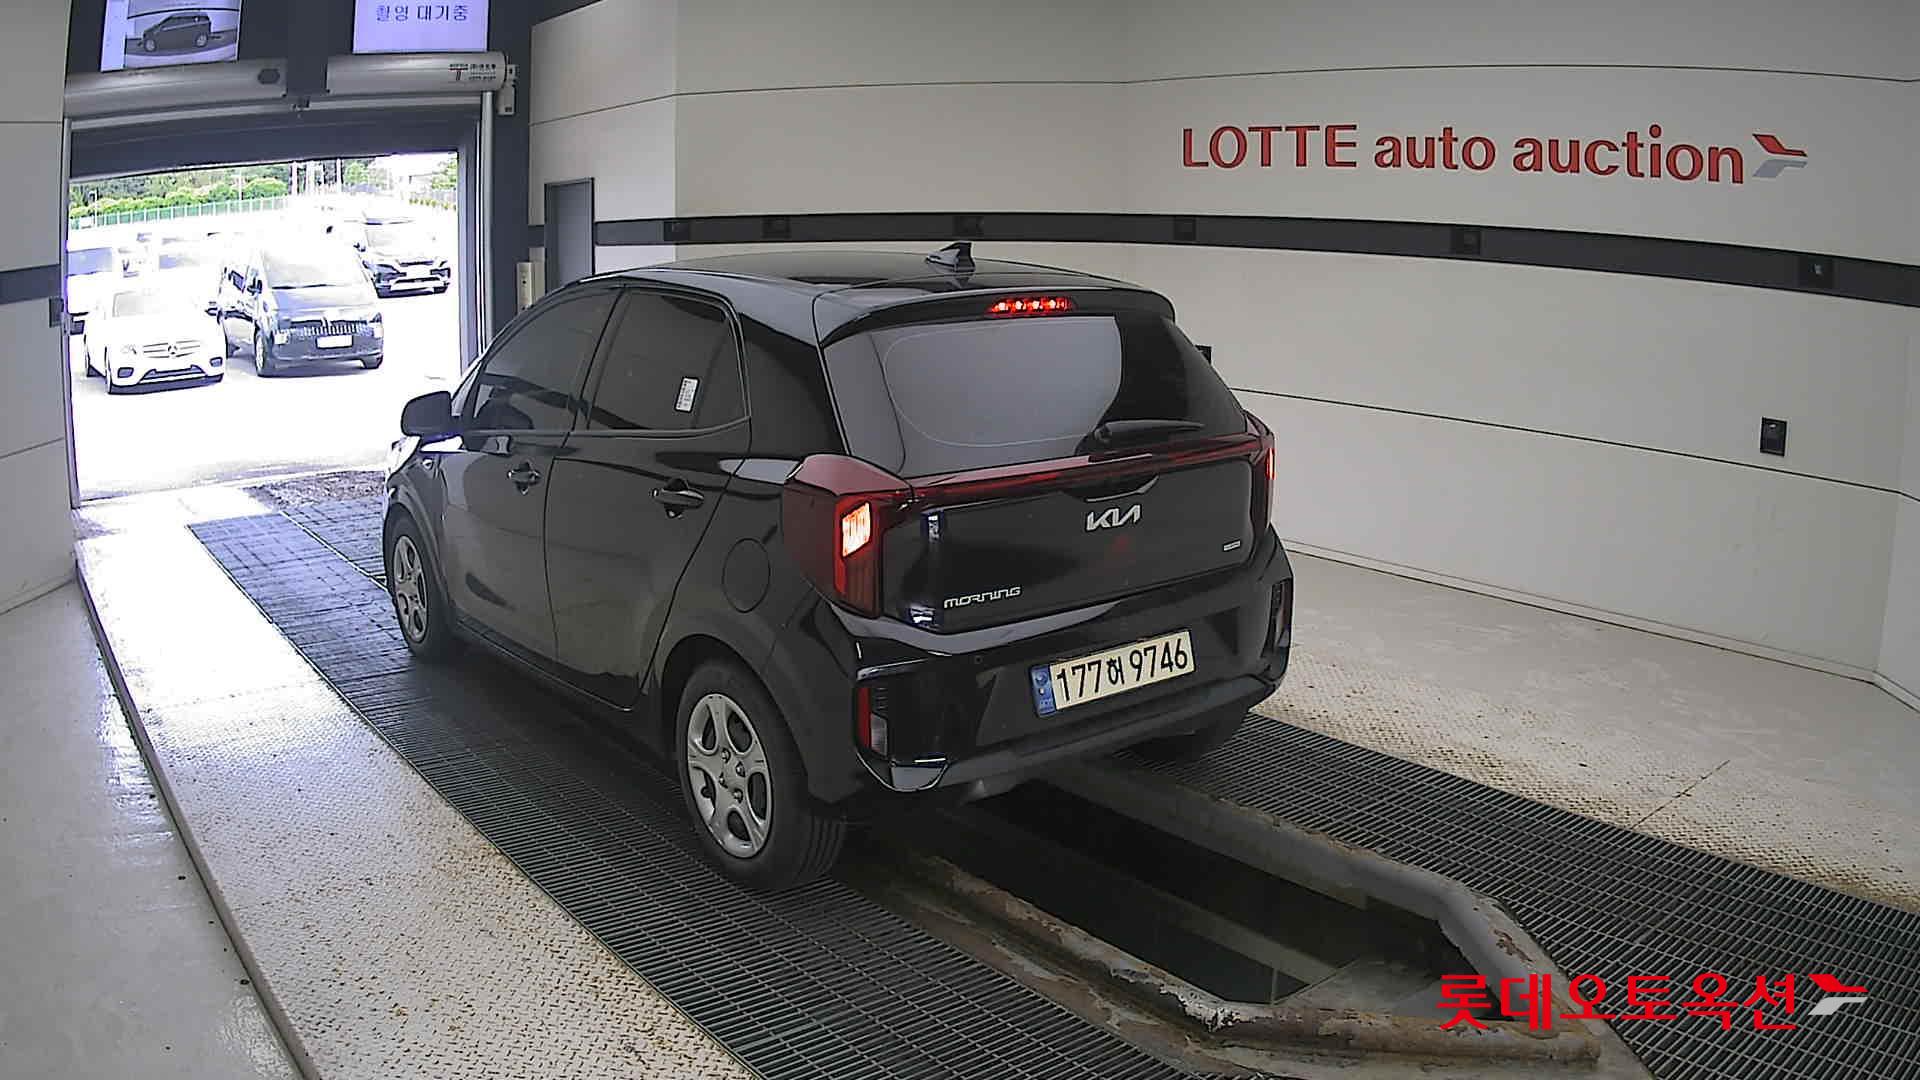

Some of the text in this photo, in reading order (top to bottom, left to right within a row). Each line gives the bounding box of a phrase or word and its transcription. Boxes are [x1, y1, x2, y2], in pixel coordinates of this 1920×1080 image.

[416, 5, 467, 21] 대기중
[1183, 124, 1744, 184] LOTTE auto auction
[1086, 503, 1142, 532] KIA
[943, 586, 1021, 609] MORNING
[1056, 637, 1188, 702] 177허 9746
